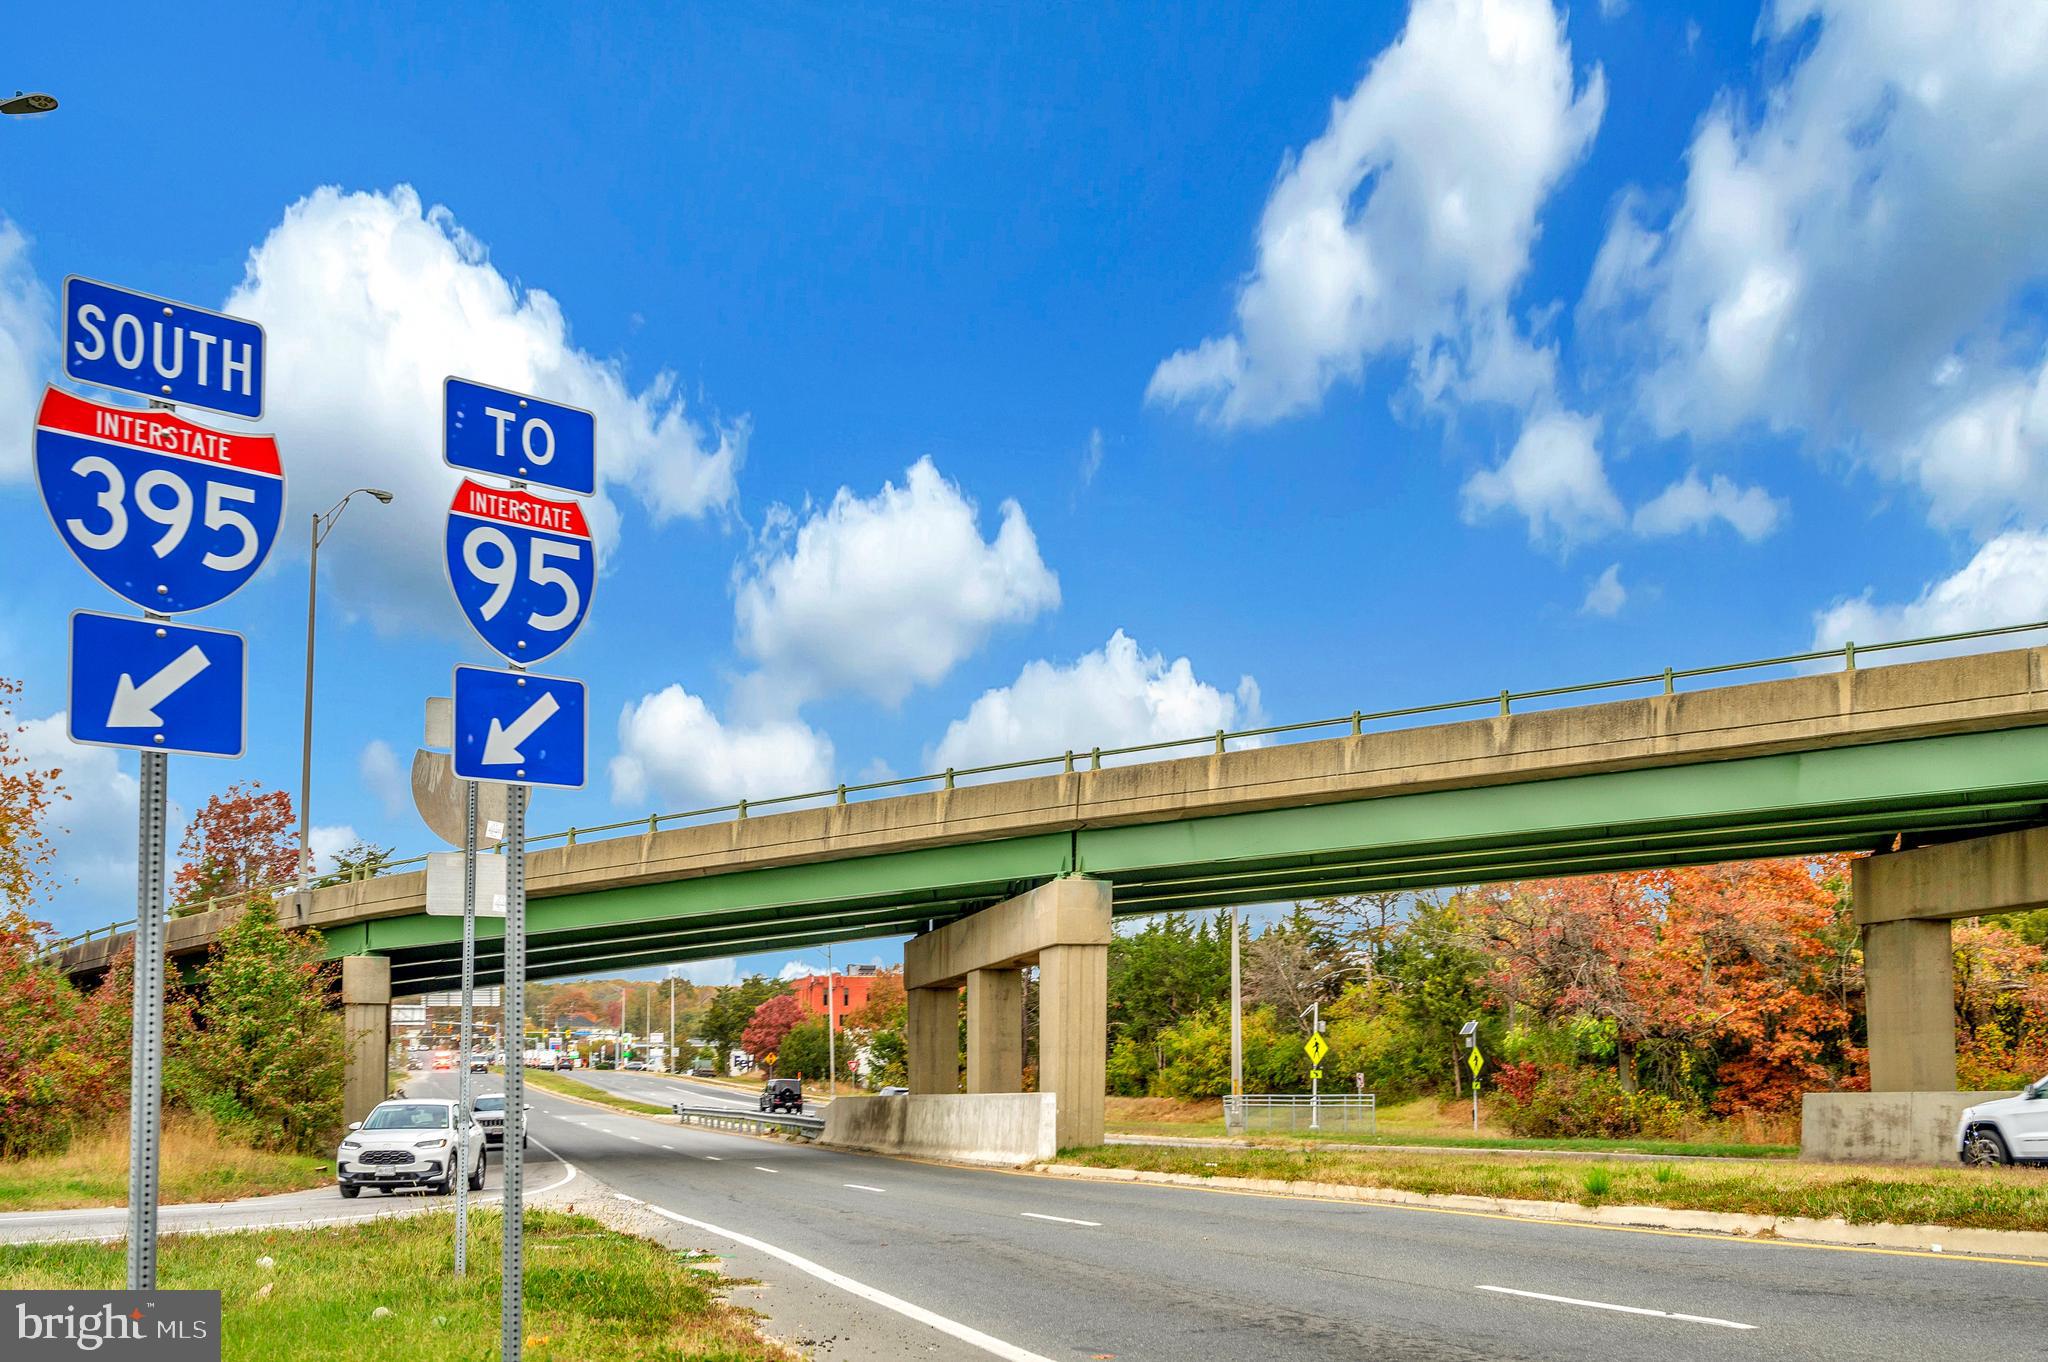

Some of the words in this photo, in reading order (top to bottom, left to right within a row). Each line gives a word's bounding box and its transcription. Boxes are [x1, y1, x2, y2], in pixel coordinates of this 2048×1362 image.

[75, 304, 252, 396] SOUTH
[96, 410, 231, 462] INTERSTATE
[485, 407, 555, 466] TO
[66, 456, 259, 572] 395
[470, 490, 572, 531] INTERSTATE
[463, 527, 581, 632] 95
